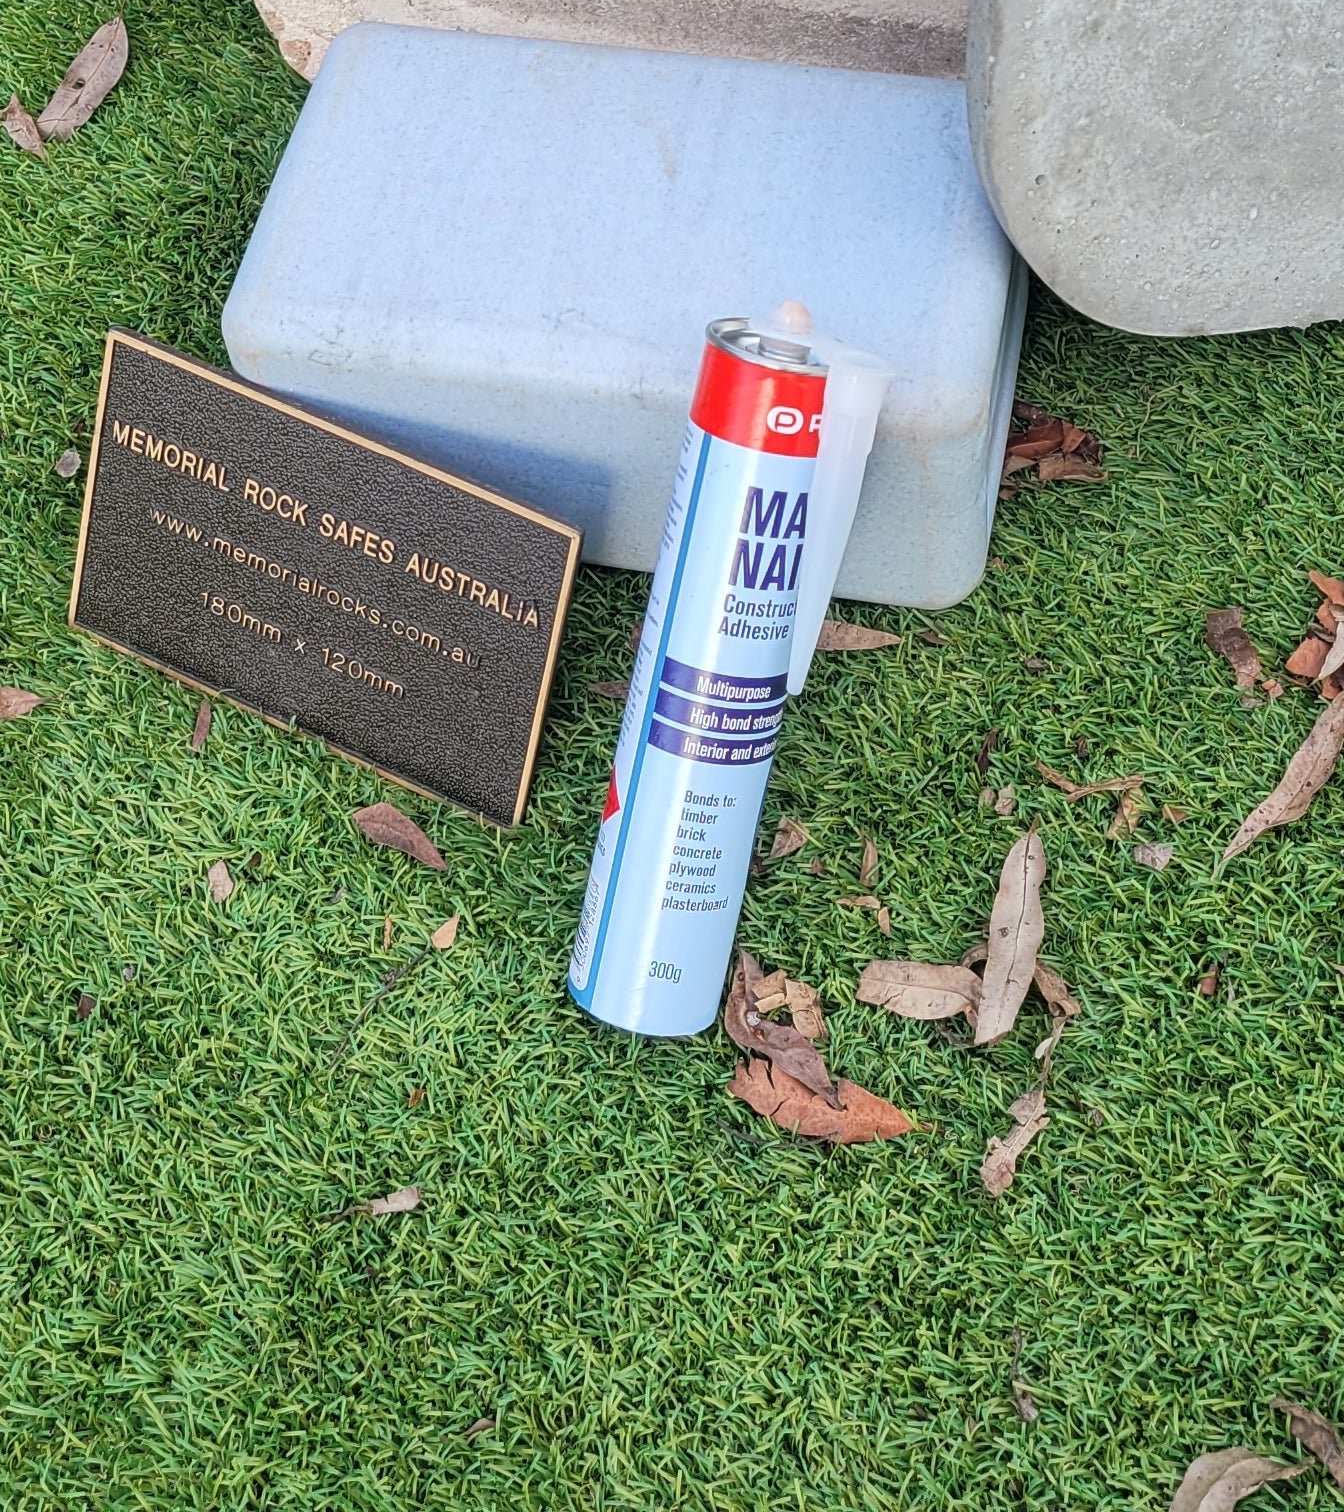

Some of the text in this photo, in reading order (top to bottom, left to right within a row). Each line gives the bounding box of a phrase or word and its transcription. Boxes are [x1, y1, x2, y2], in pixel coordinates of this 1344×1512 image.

[112, 419, 230, 492] MEMORIAL
[243, 478, 308, 526] ROCK
[319, 513, 395, 564] SAFES
[150, 508, 481, 669] www.memorialrocks.com.au
[717, 615, 789, 640] Adhesive
[201, 591, 404, 697] 180mm x 120mm
[696, 675, 771, 702] Multipurpose
[689, 707, 718, 729] High
[721, 714, 752, 731] bond
[683, 736, 729, 760] Interior
[730, 744, 753, 761] and
[684, 790, 737, 807] Bonds to:
[680, 807, 718, 824] timber
[677, 824, 706, 841] brick
[673, 845, 722, 860] concrete
[668, 861, 716, 878] plywood
[665, 880, 716, 894] ceramics
[661, 896, 729, 912] plasterboard
[649, 960, 682, 984] 300g
